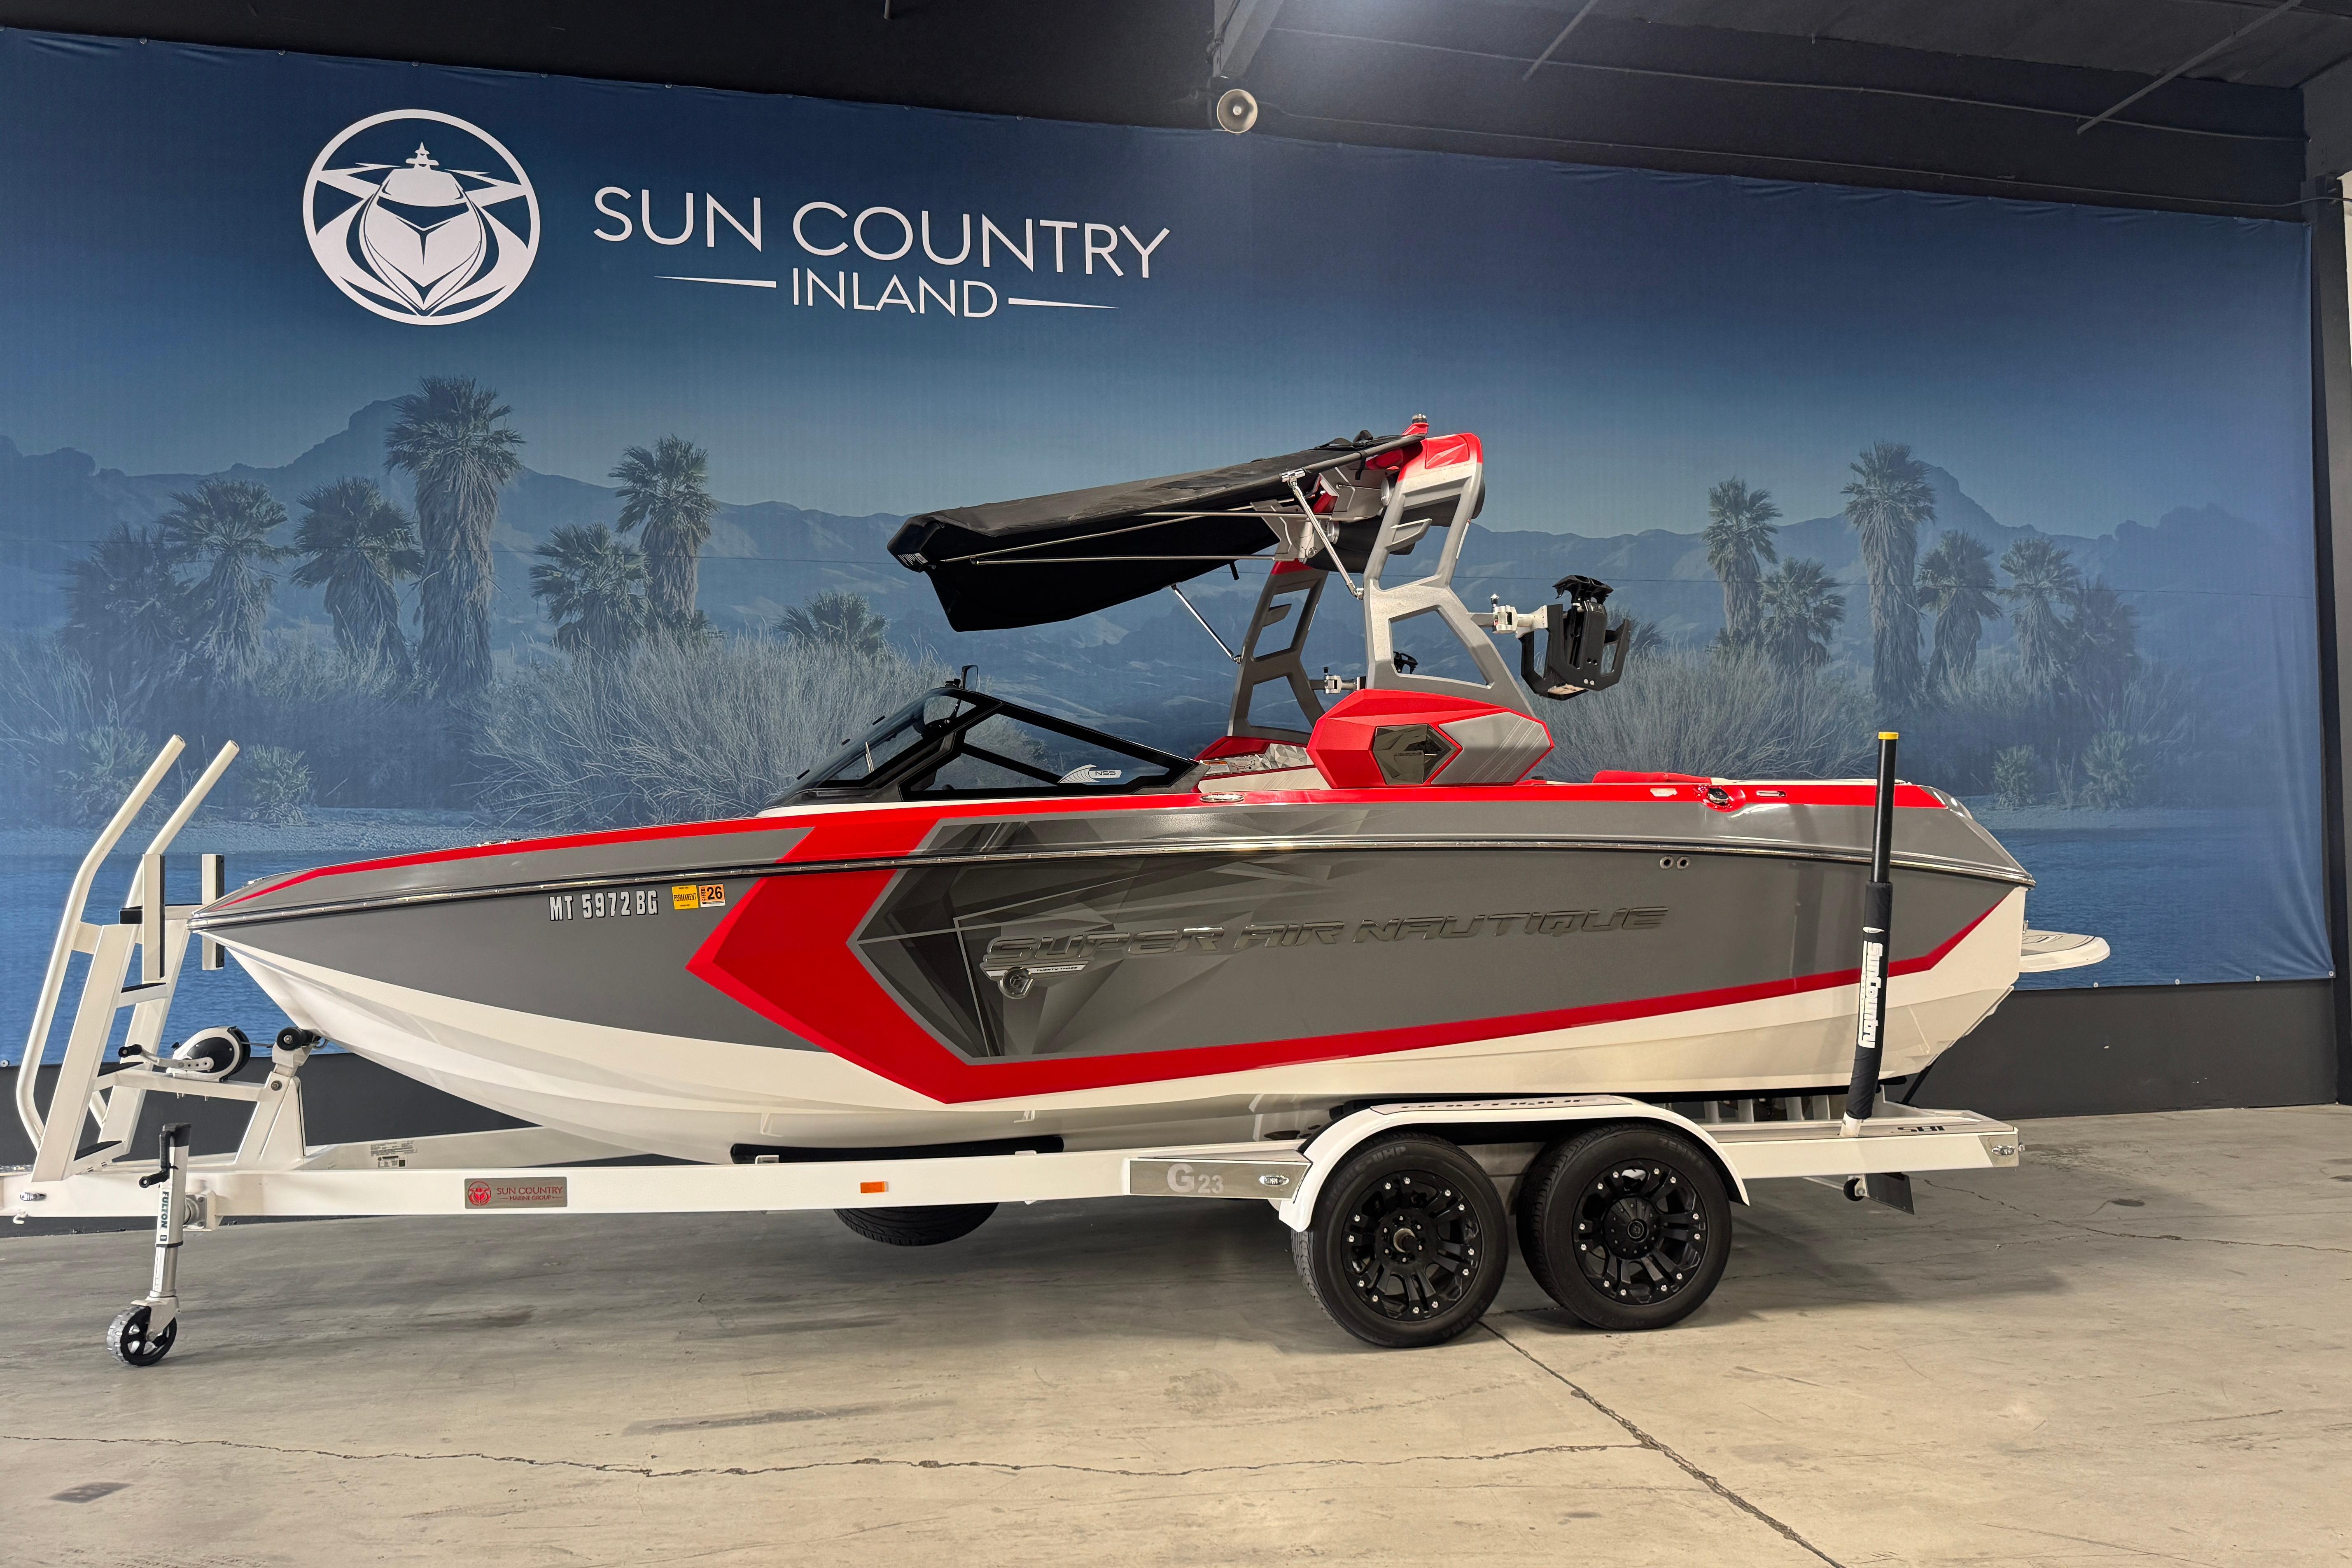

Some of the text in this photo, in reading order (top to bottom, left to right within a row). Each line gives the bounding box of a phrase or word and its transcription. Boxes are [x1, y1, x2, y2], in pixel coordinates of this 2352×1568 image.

[593, 187, 1170, 278] SUN COUNTRY
[793, 268, 997, 317] INLAND
[549, 890, 658, 921] MT 5972 BG
[707, 886, 723, 900] 26
[985, 907, 1670, 963] SUPER AIR NAUTIQUE
[519, 1186, 564, 1195] COUNTRY
[160, 1191, 169, 1229] FULTON
